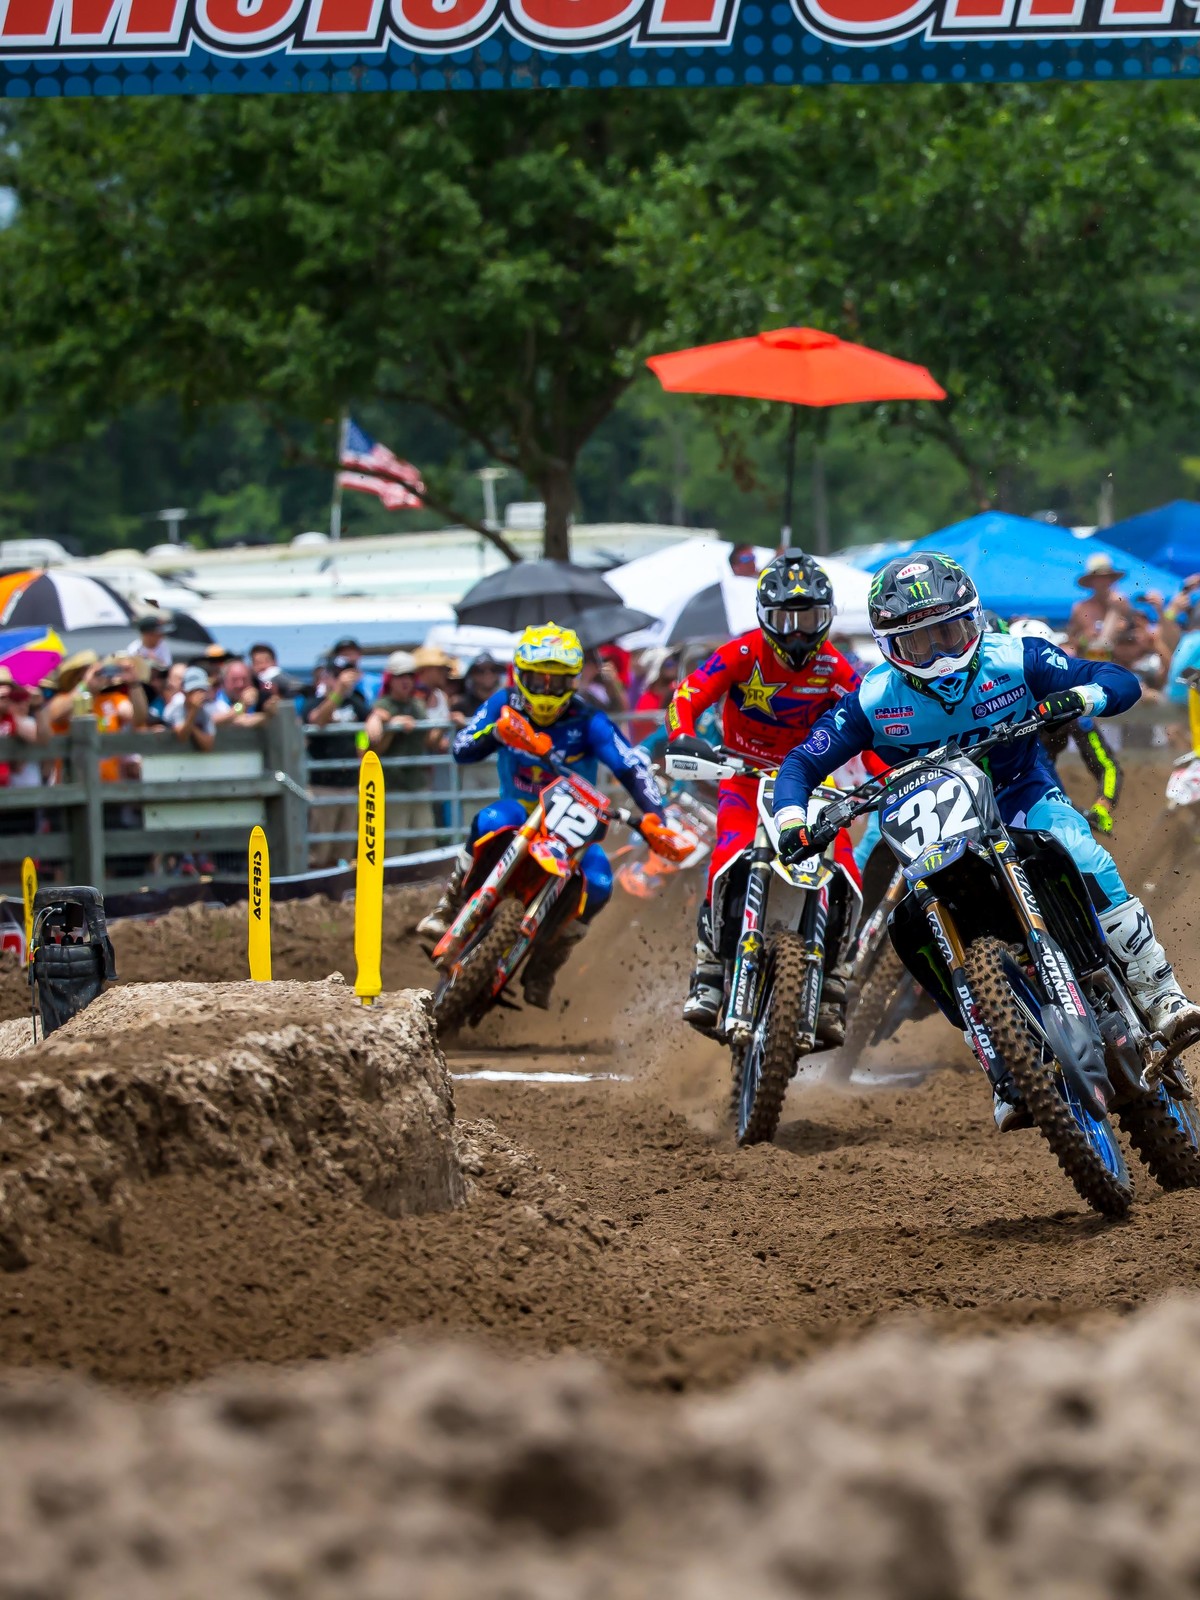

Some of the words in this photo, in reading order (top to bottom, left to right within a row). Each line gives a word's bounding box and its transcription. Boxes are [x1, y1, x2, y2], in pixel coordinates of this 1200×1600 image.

[874, 706, 913, 716] PARTS
[898, 773, 926, 799] LUCAS
[898, 774, 980, 862] 32
[365, 780, 375, 866] ACERBIS
[544, 792, 598, 848] 12
[253, 850, 262, 920] ACERBIS
[808, 967, 824, 1029] DUNLOP
[1038, 938, 1079, 1016] DUNLOP
